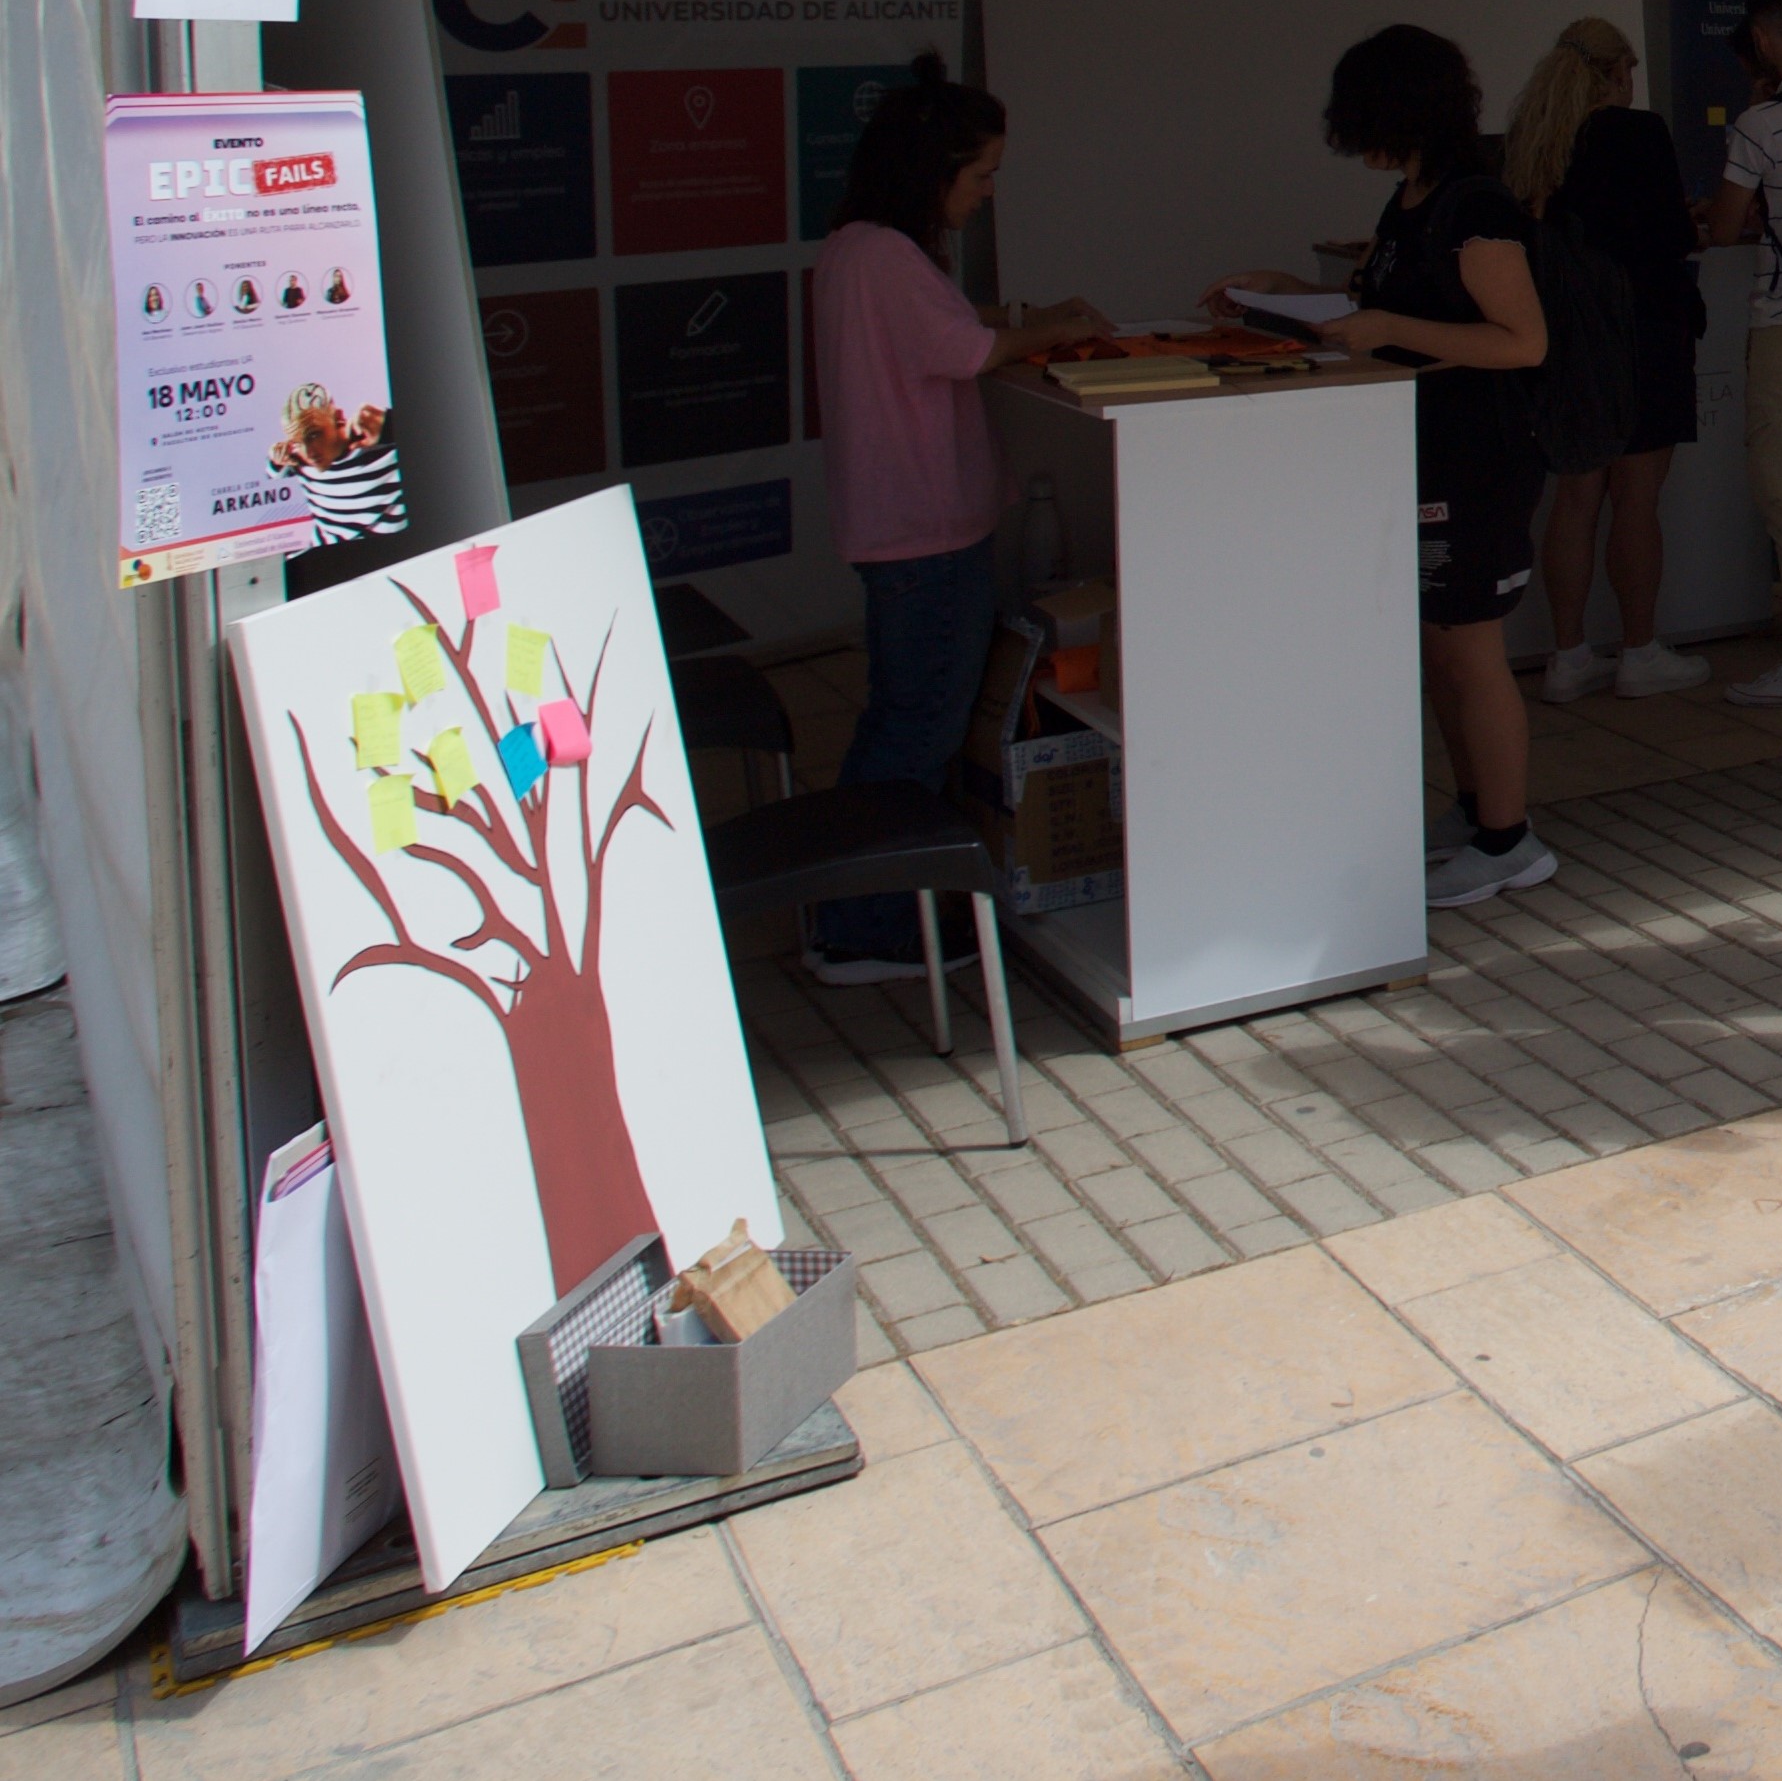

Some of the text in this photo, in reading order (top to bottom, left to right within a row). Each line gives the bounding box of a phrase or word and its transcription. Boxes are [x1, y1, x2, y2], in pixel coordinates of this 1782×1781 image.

[600, 0, 958, 21] UNIVERSIDAD DE ALICANTE
[214, 138, 263, 149] EVENTO
[150, 158, 324, 200] EPIC FAILS
[148, 374, 255, 408] 18 MAYO
[1711, 385, 1733, 401] LA
[176, 403, 227, 422] 12:00
[212, 487, 292, 516] ARKANO
